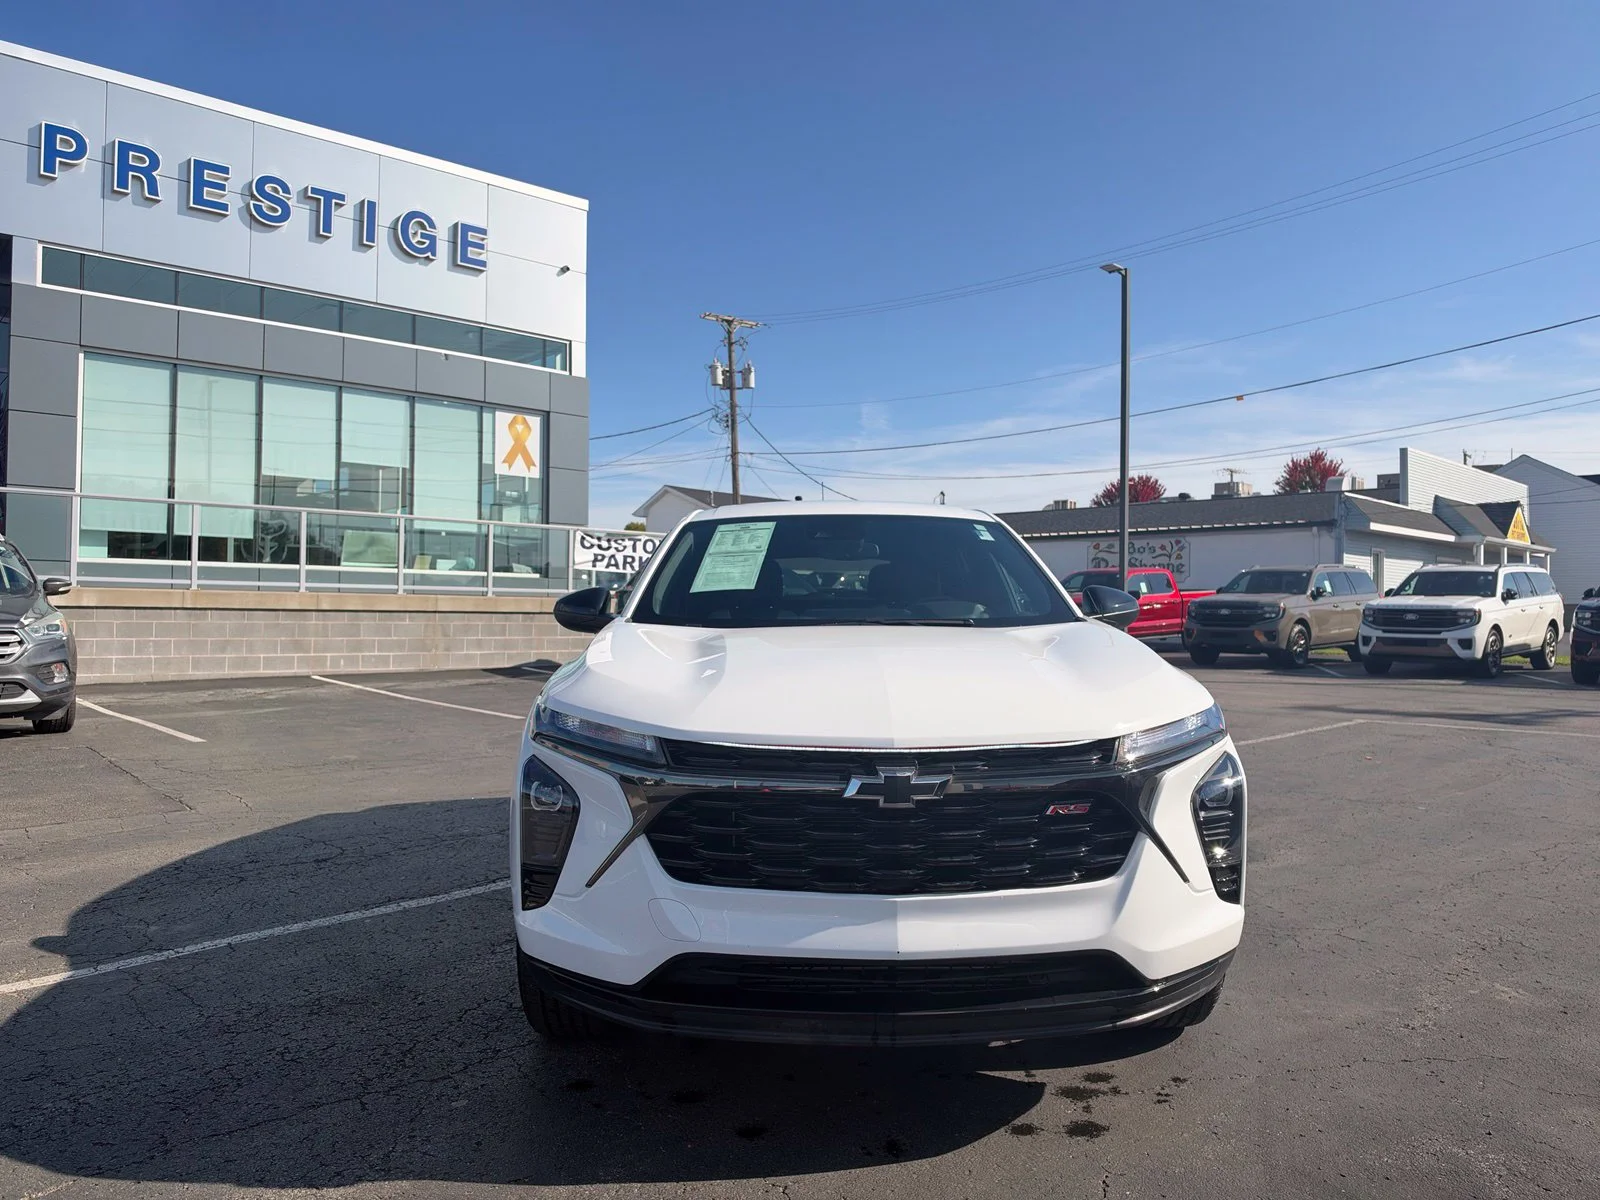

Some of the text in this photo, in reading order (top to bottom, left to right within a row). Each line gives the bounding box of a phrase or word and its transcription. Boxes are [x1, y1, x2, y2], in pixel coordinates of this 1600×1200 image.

[39, 120, 489, 272] PRESTIGE
[580, 533, 664, 554] CUSTO
[1045, 803, 1091, 815] RS
